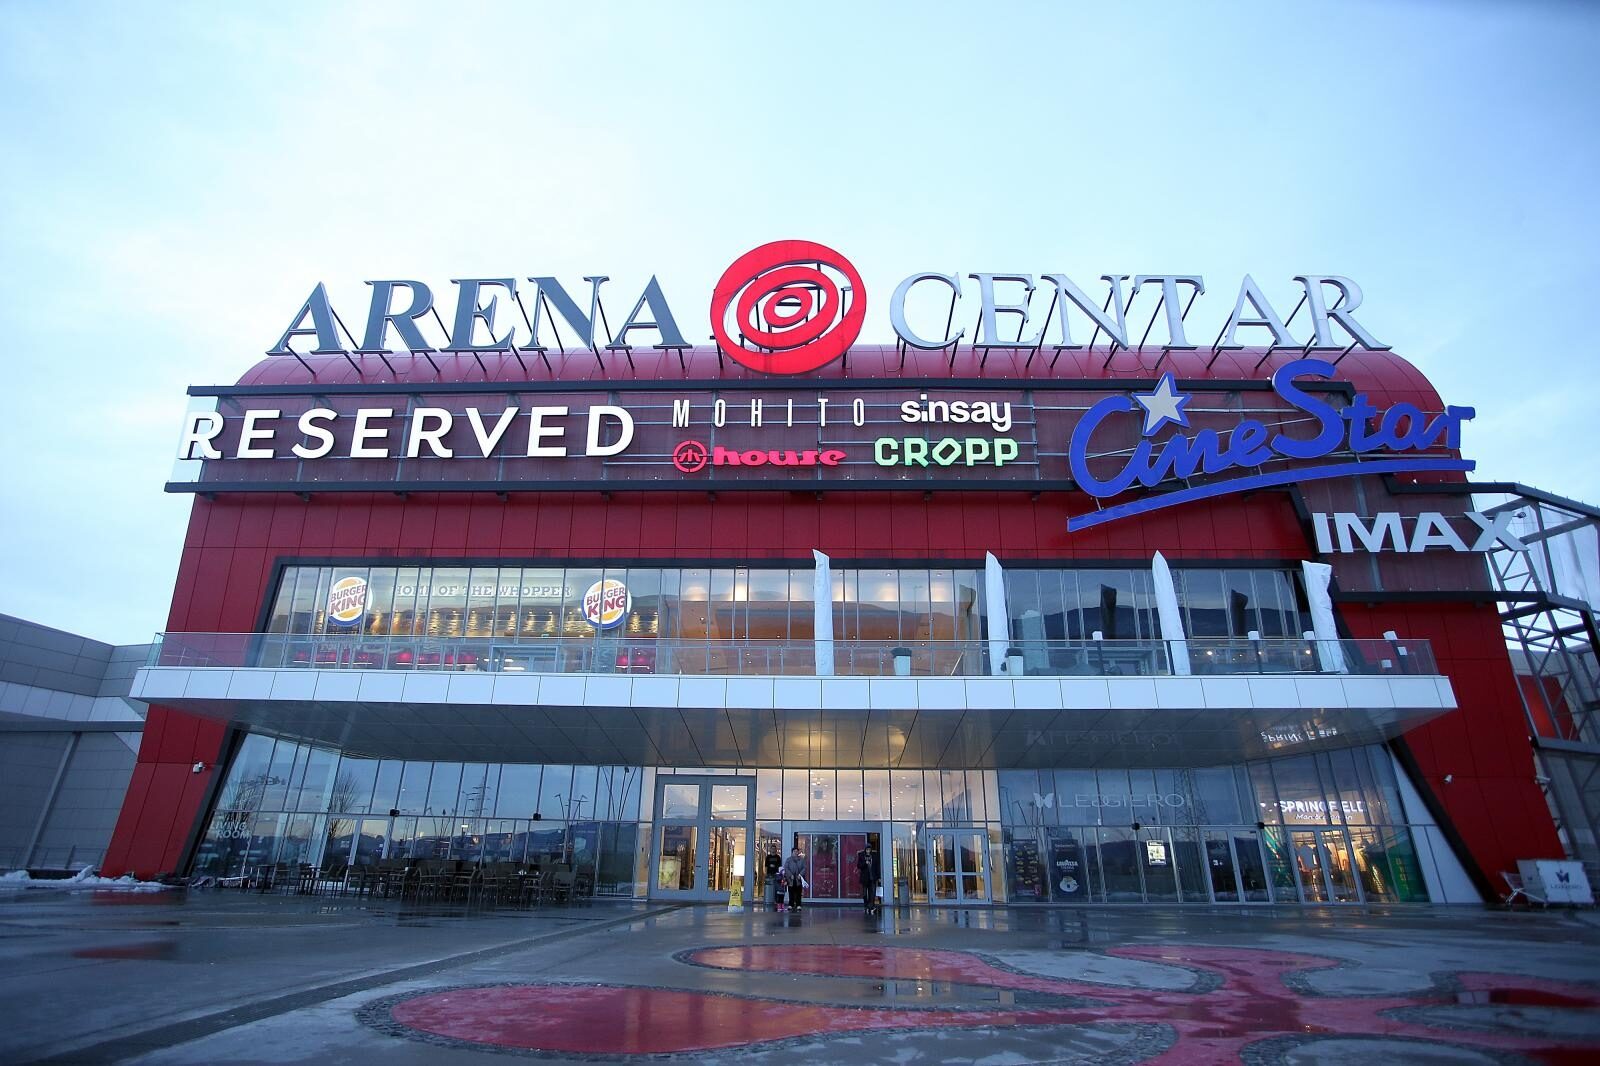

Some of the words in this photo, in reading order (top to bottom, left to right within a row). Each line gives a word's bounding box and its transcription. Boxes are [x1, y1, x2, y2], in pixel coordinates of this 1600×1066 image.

[265, 274, 692, 355] ARENA
[889, 273, 1392, 351] CENTAR
[672, 398, 864, 427] MOHITO
[900, 394, 1012, 431] sinsay
[178, 404, 635, 459] RESERVED
[1069, 359, 1475, 497] CineStar
[713, 446, 847, 466] house
[874, 437, 1018, 466] CROPP
[1312, 511, 1531, 553] IMAX
[438, 585, 458, 596] OF
[462, 586, 493, 597] HE
[586, 586, 626, 606] BUGER
[587, 595, 625, 618] KNG
